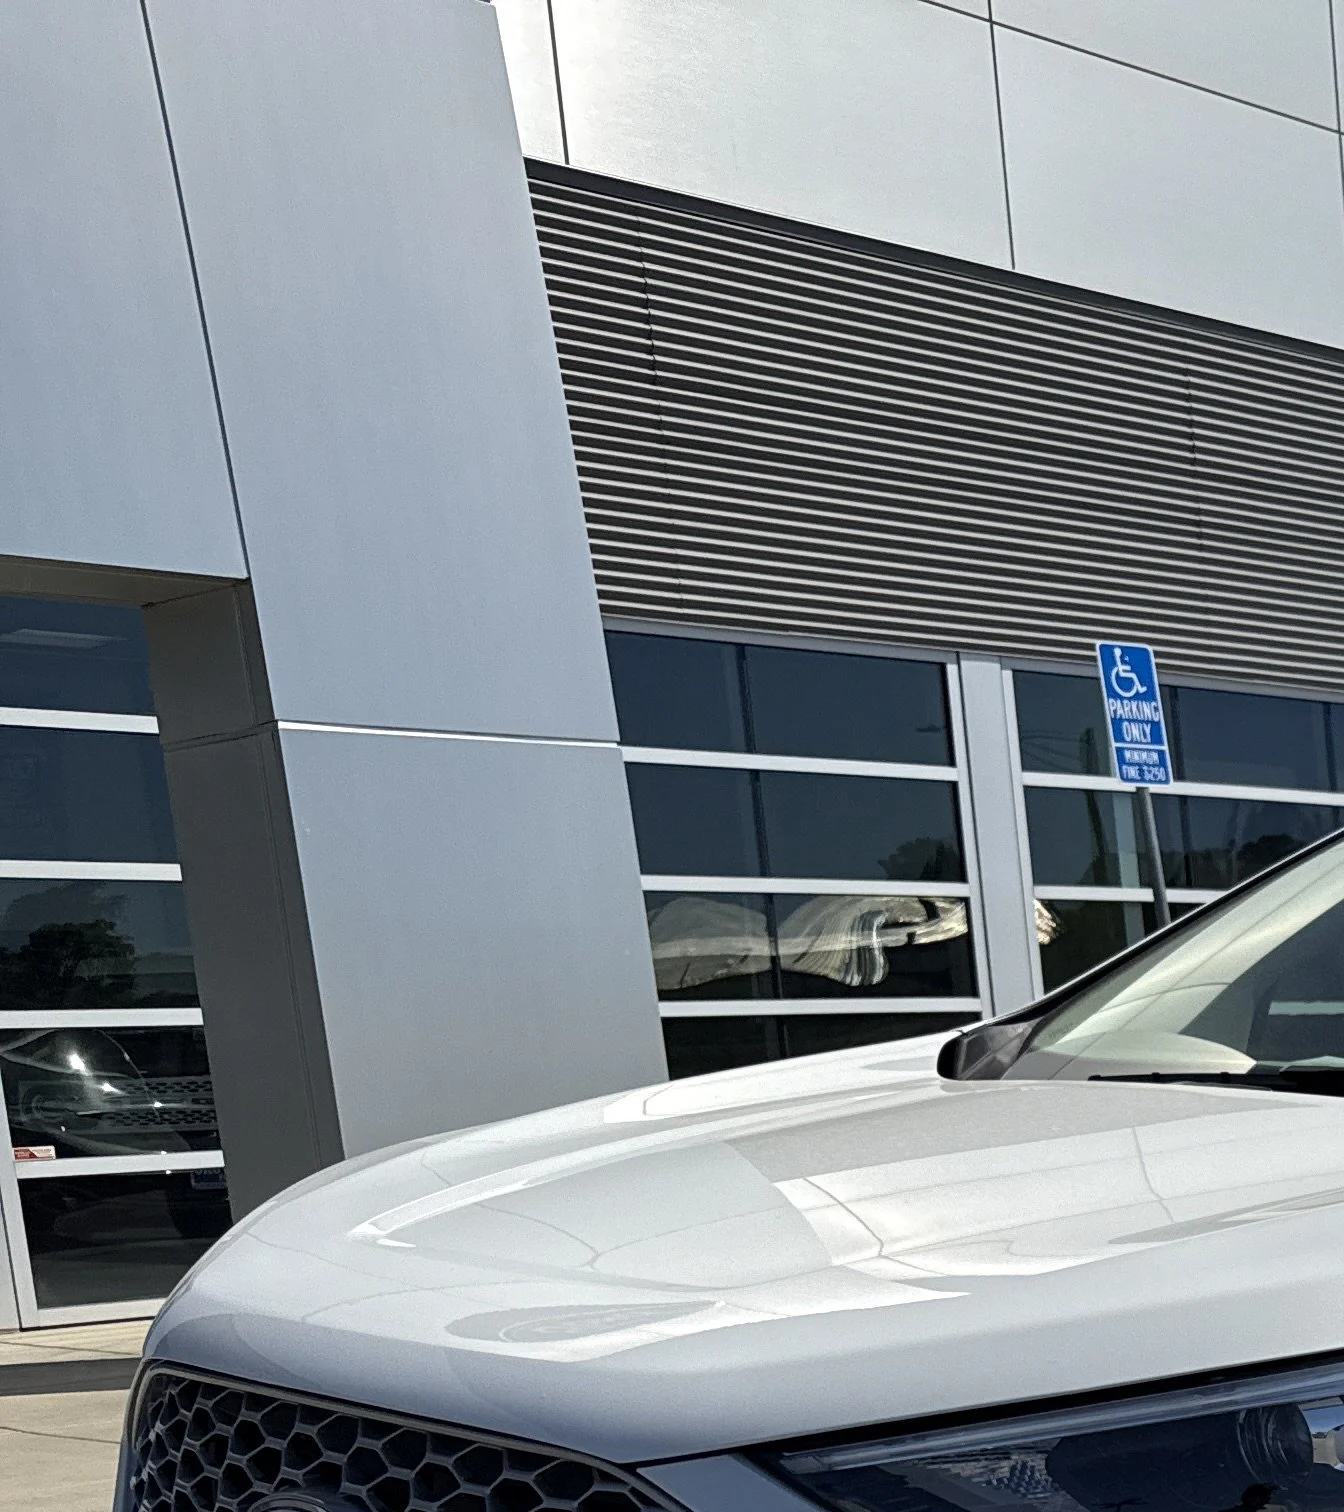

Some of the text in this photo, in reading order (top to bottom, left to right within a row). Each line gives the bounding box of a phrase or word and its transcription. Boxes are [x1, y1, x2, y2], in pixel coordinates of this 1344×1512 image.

[1109, 698, 1160, 722] PARKING
[1122, 721, 1152, 743] ONLY
[1124, 749, 1159, 765] MINIMUM
[1122, 764, 1167, 781] FINE $250
